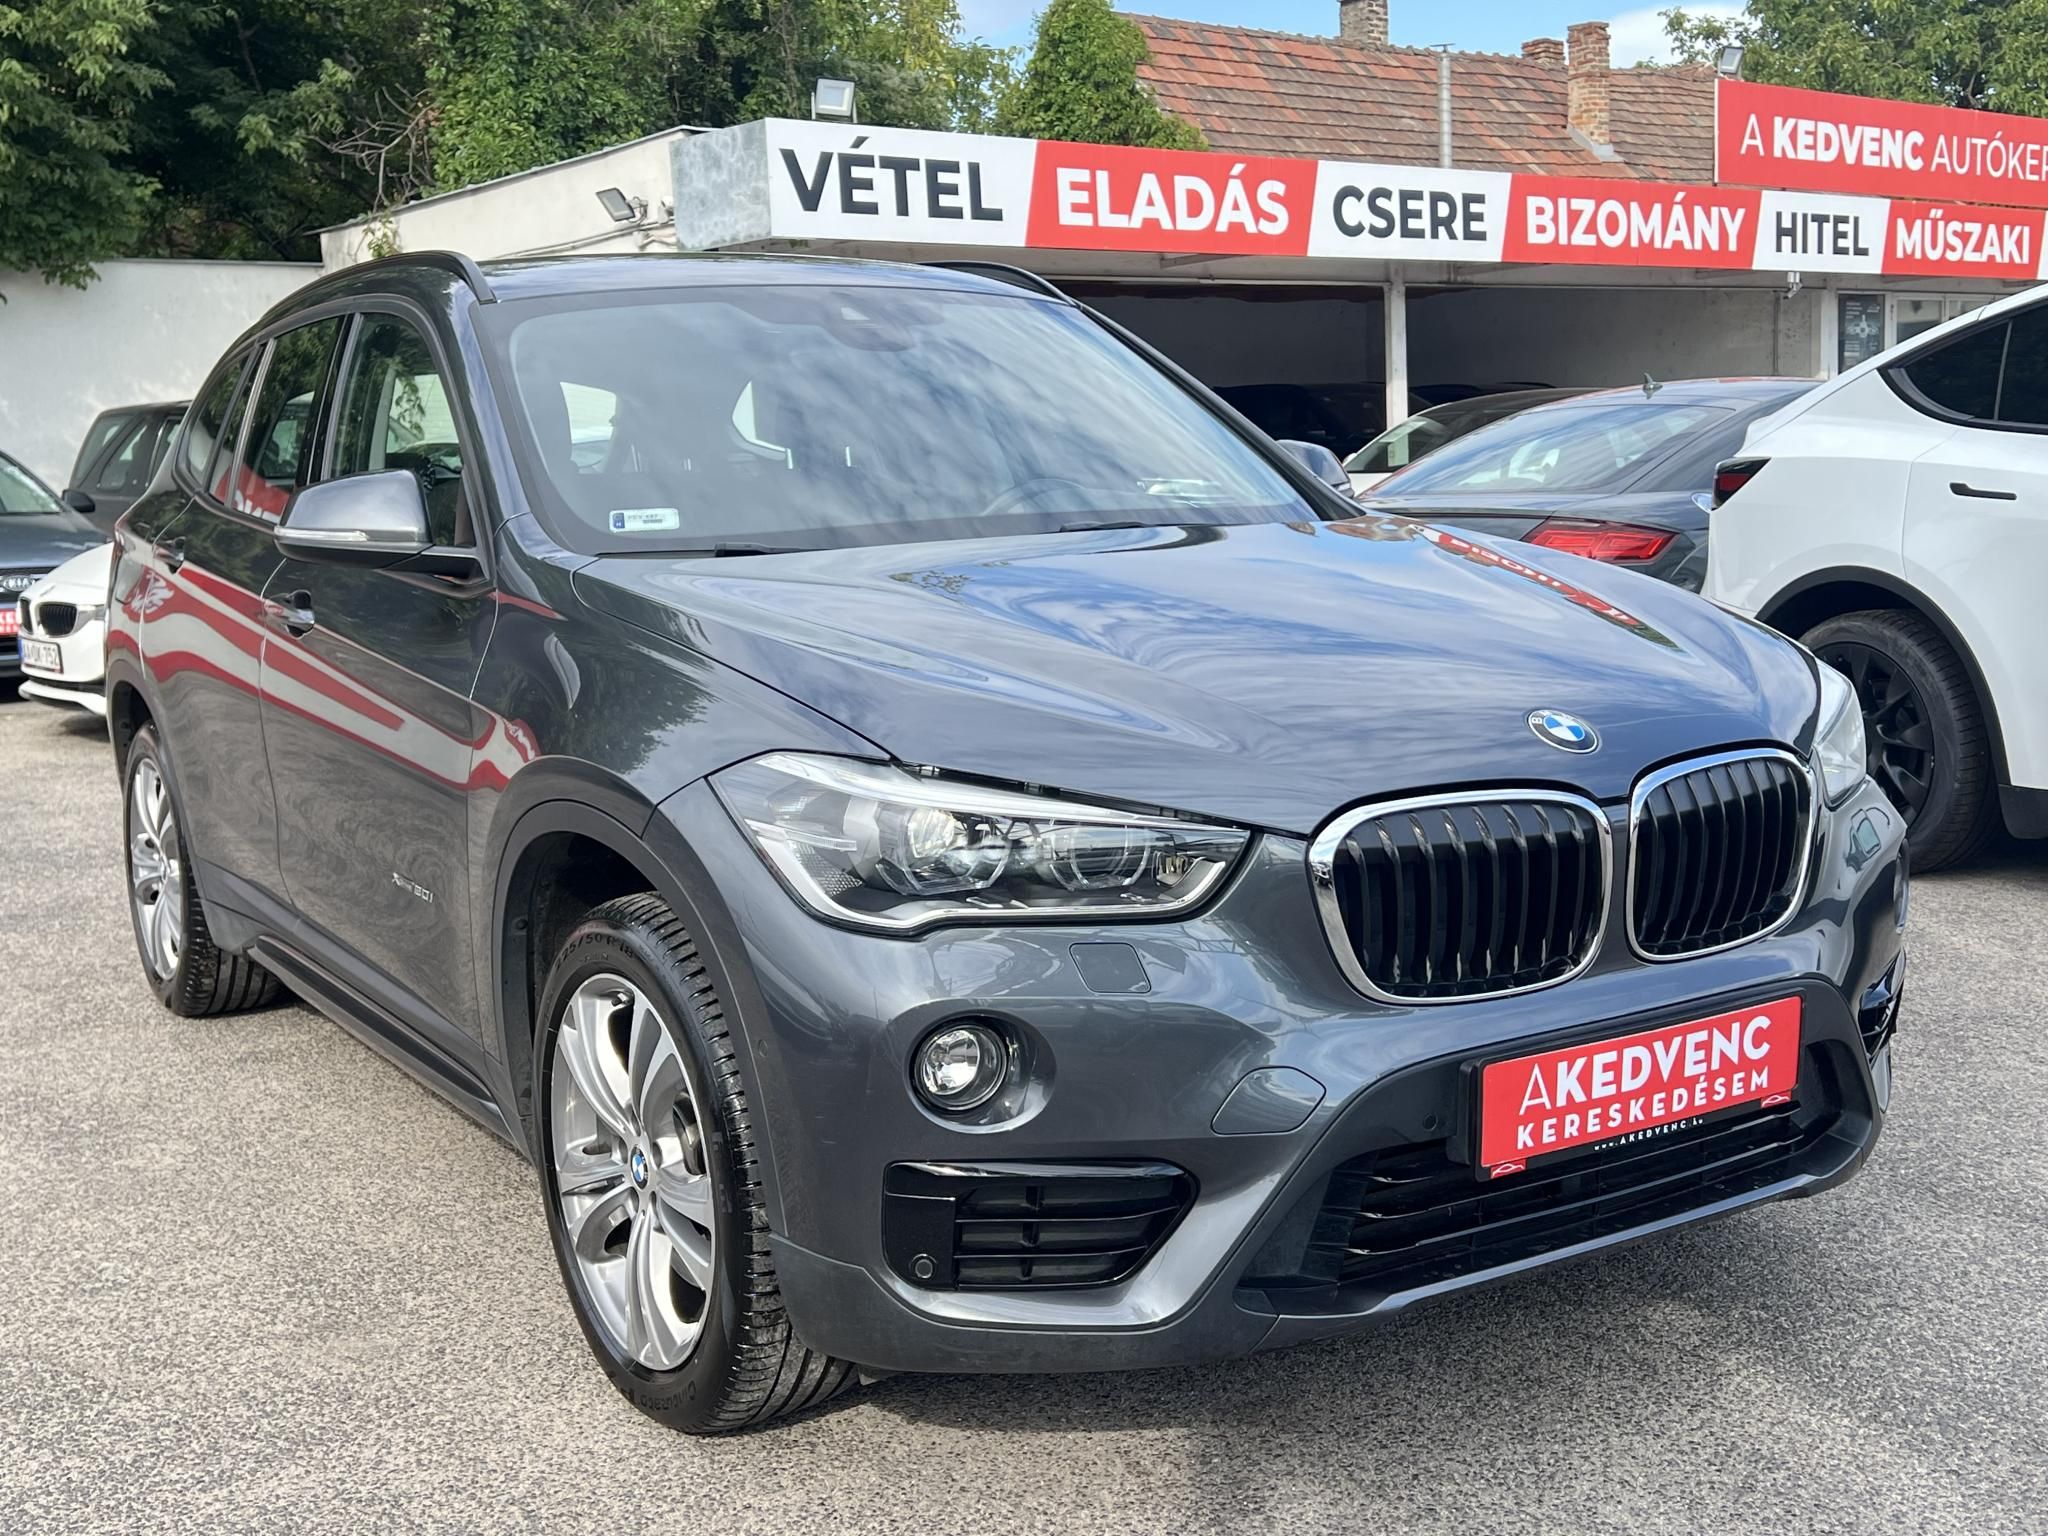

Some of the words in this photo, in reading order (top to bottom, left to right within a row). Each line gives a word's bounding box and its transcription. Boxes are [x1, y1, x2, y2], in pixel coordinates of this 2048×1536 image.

[1740, 113, 1765, 156] A
[1773, 115, 1925, 171] KEDVENC
[778, 135, 1003, 222] VÉTEL
[1056, 163, 1288, 236] ELADÁS
[1333, 184, 1488, 242] CSERE
[1526, 191, 1746, 252] BIZOMÁNY
[1775, 210, 1870, 257] HITEL
[1896, 208, 2031, 264] MŰSZAKI
[1516, 1065, 1769, 1150] KERESKEDÉSEM
